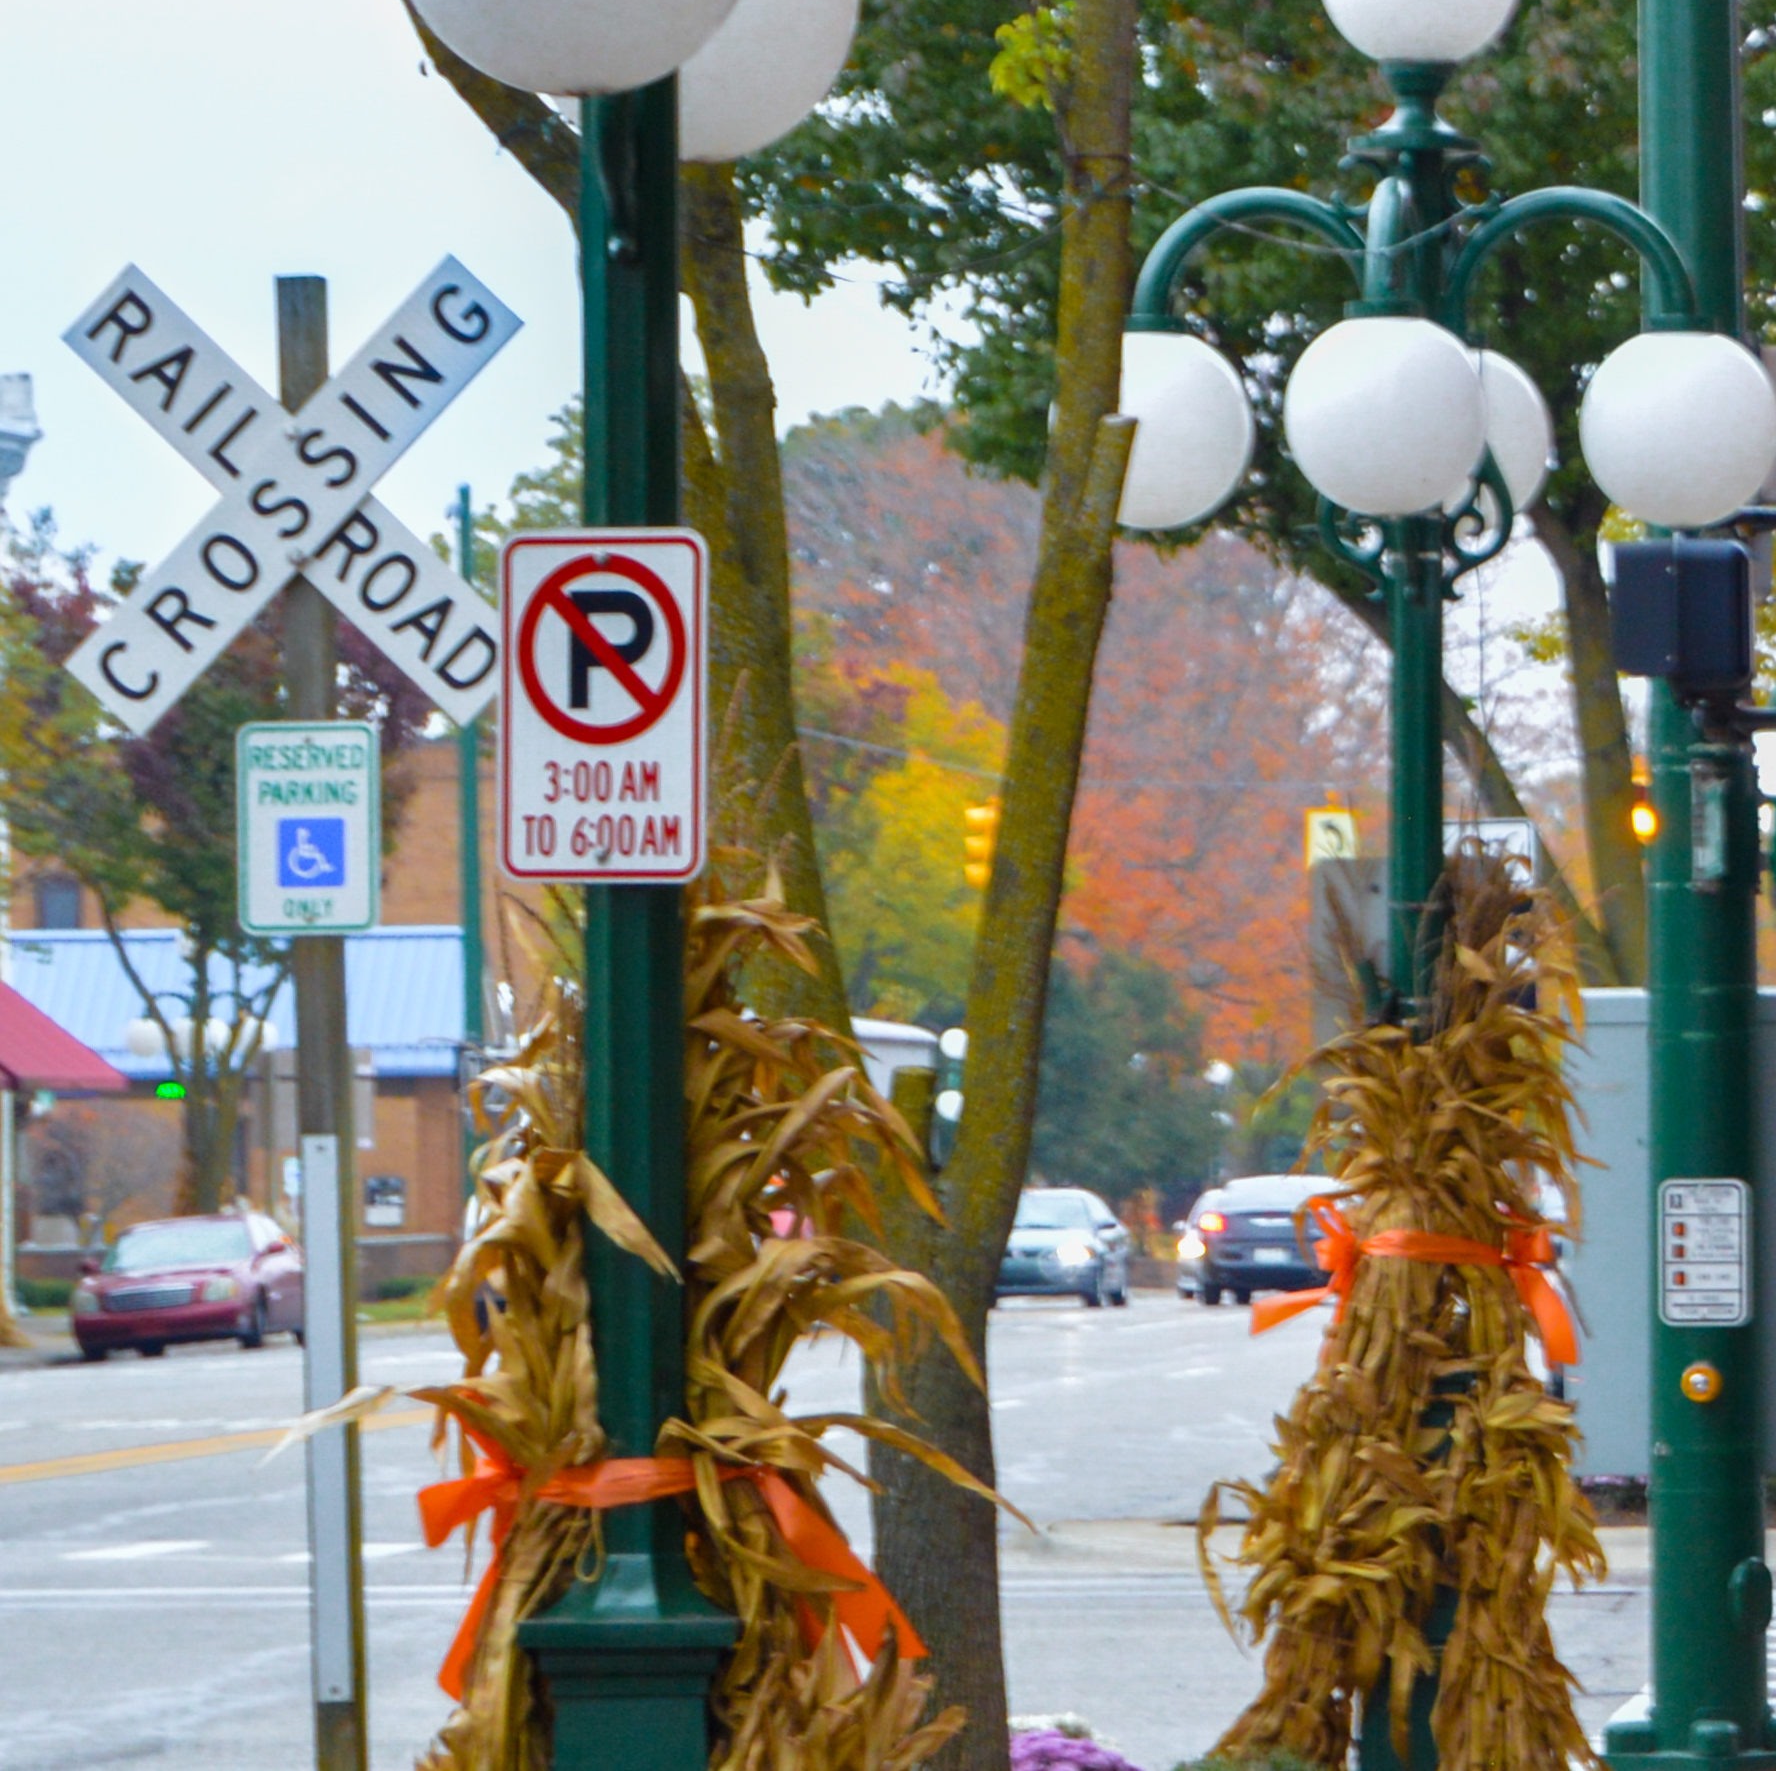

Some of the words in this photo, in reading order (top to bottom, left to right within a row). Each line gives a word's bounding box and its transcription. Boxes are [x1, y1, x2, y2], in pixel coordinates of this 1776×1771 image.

[85, 288, 259, 479] RAIL
[312, 510, 499, 693] ROAD
[99, 283, 493, 703] CROSSING
[249, 744, 364, 770] RESERVED
[257, 780, 359, 806] PARKING
[543, 760, 613, 803] 3:00
[618, 760, 661, 803] AM
[522, 814, 557, 857] TO
[282, 898, 334, 919] ONLY
